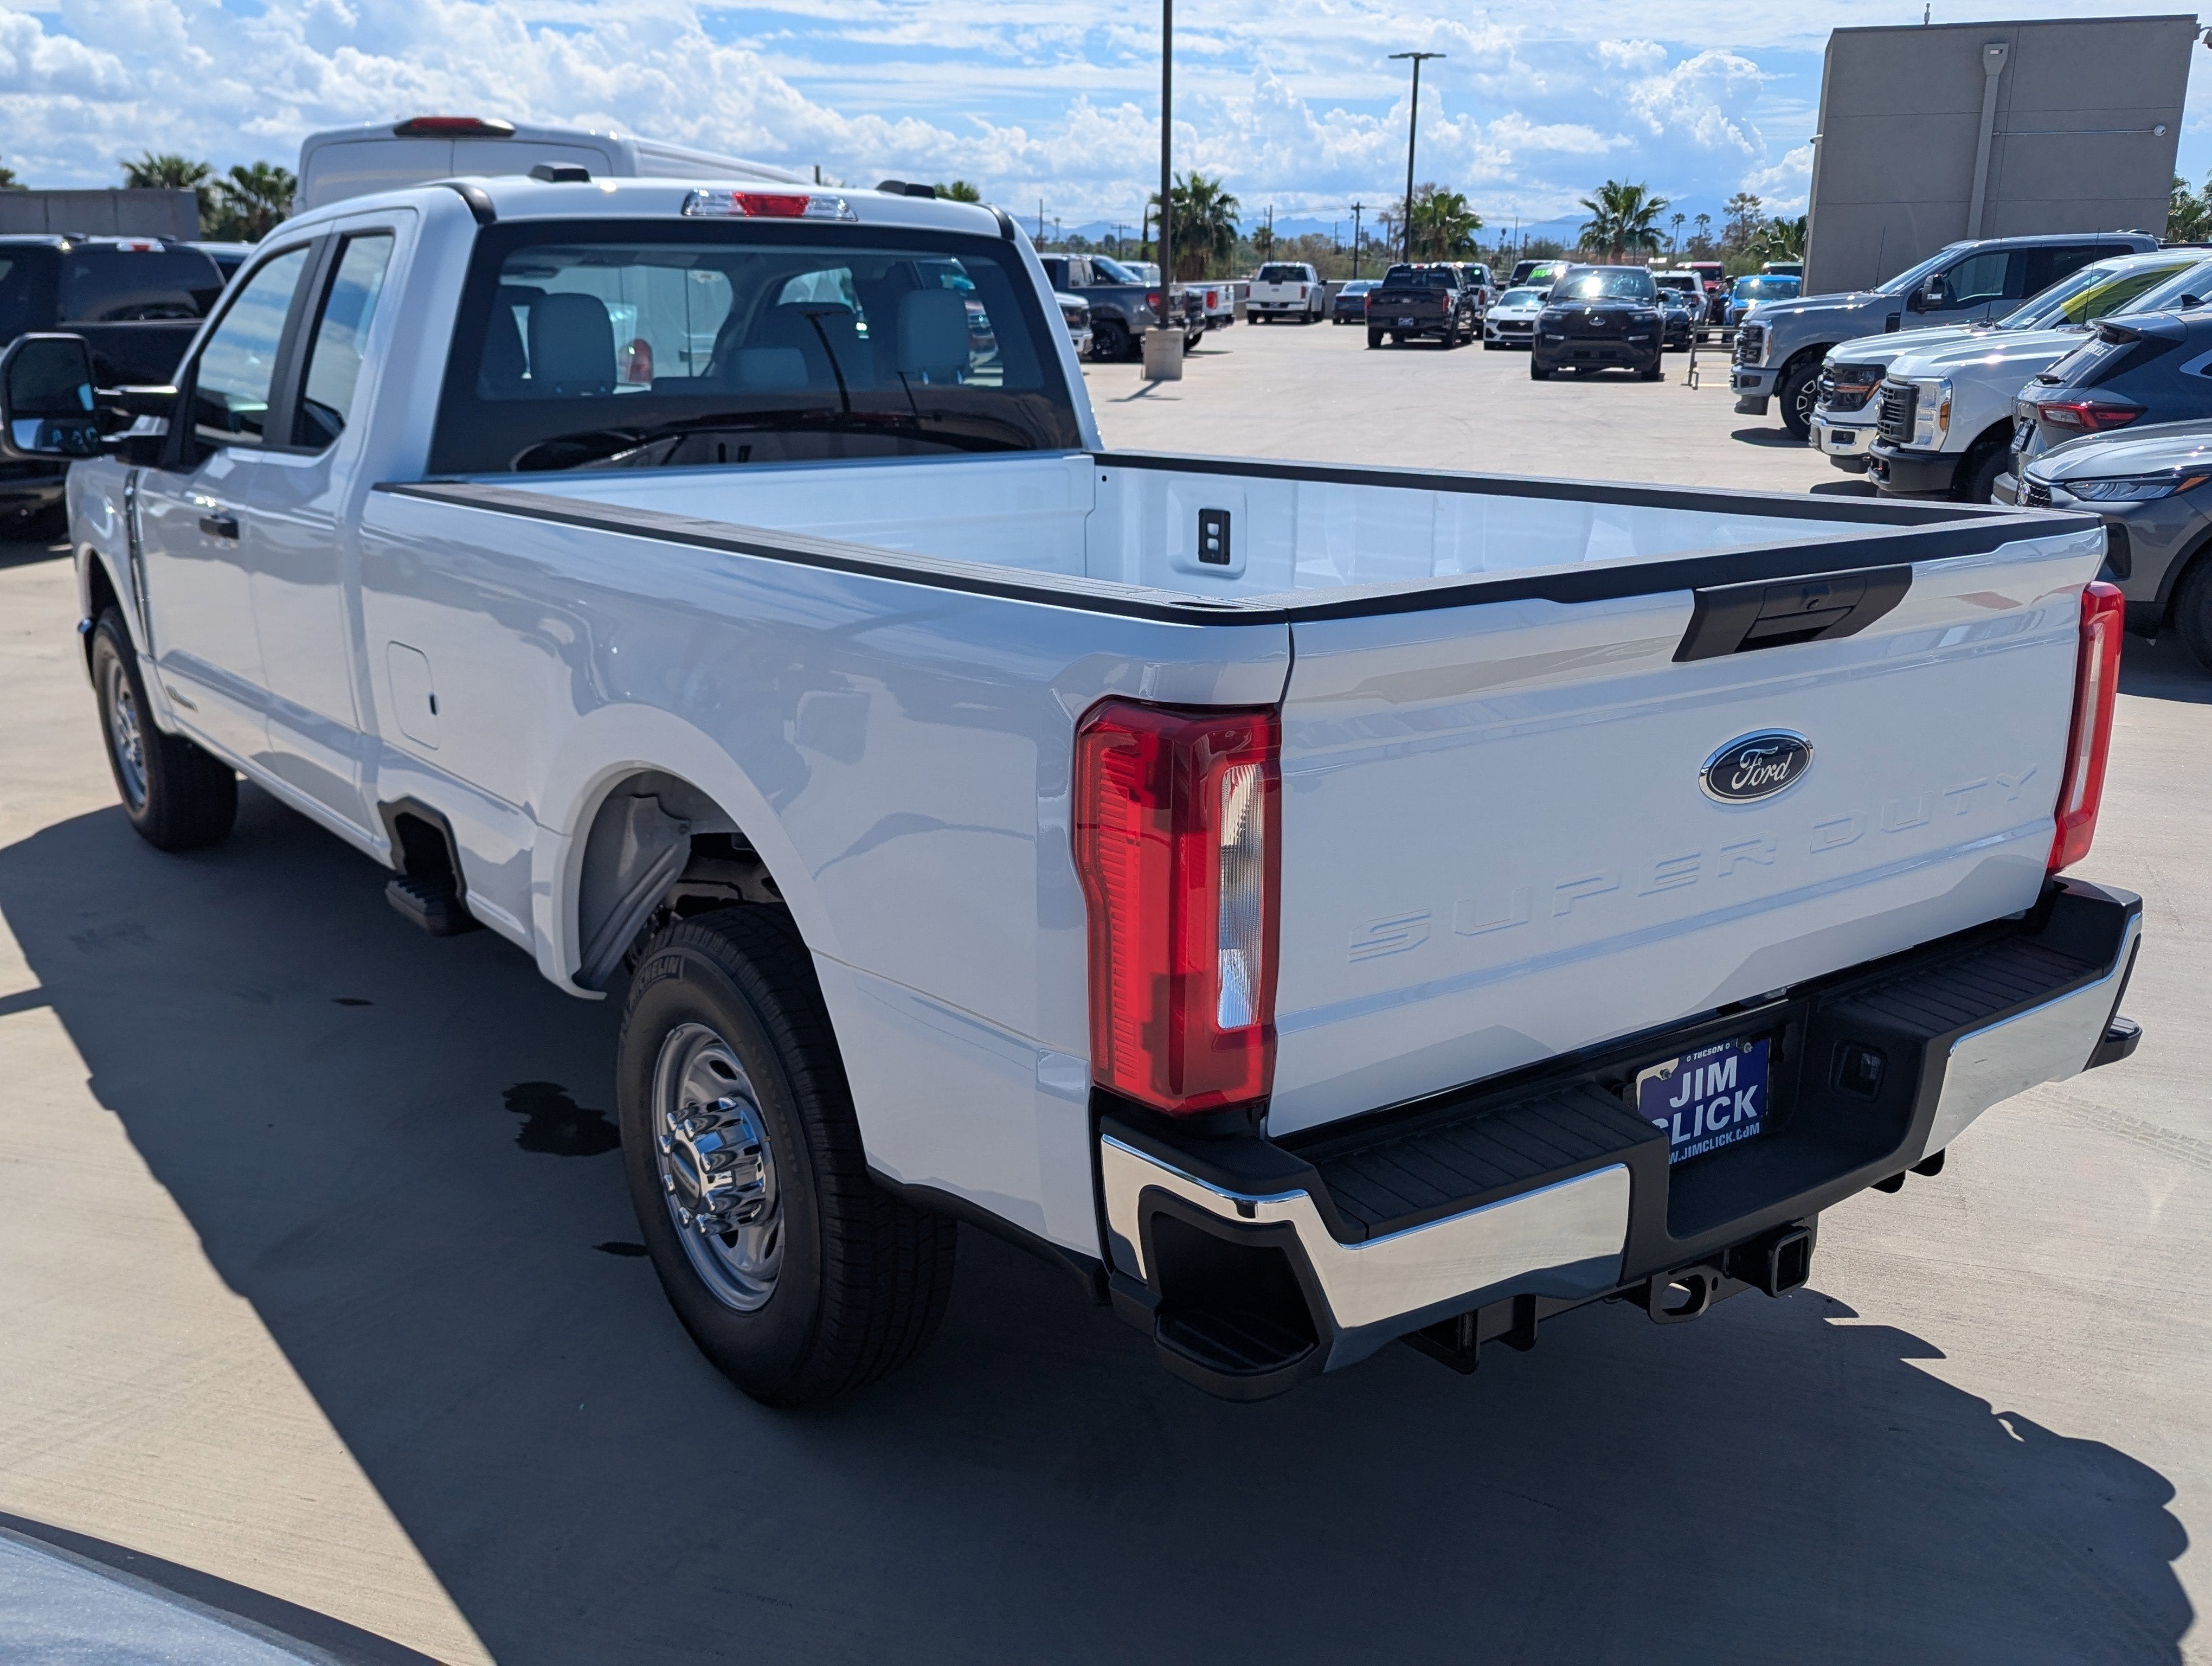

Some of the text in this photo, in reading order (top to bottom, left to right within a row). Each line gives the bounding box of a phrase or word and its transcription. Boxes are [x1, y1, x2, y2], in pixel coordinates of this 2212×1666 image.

[1731, 746, 1793, 790] Ford
[1348, 764, 2037, 964] SUPER DUTY
[1693, 1044, 1724, 1060] TUCSON
[1669, 1055, 1738, 1108] JIM
